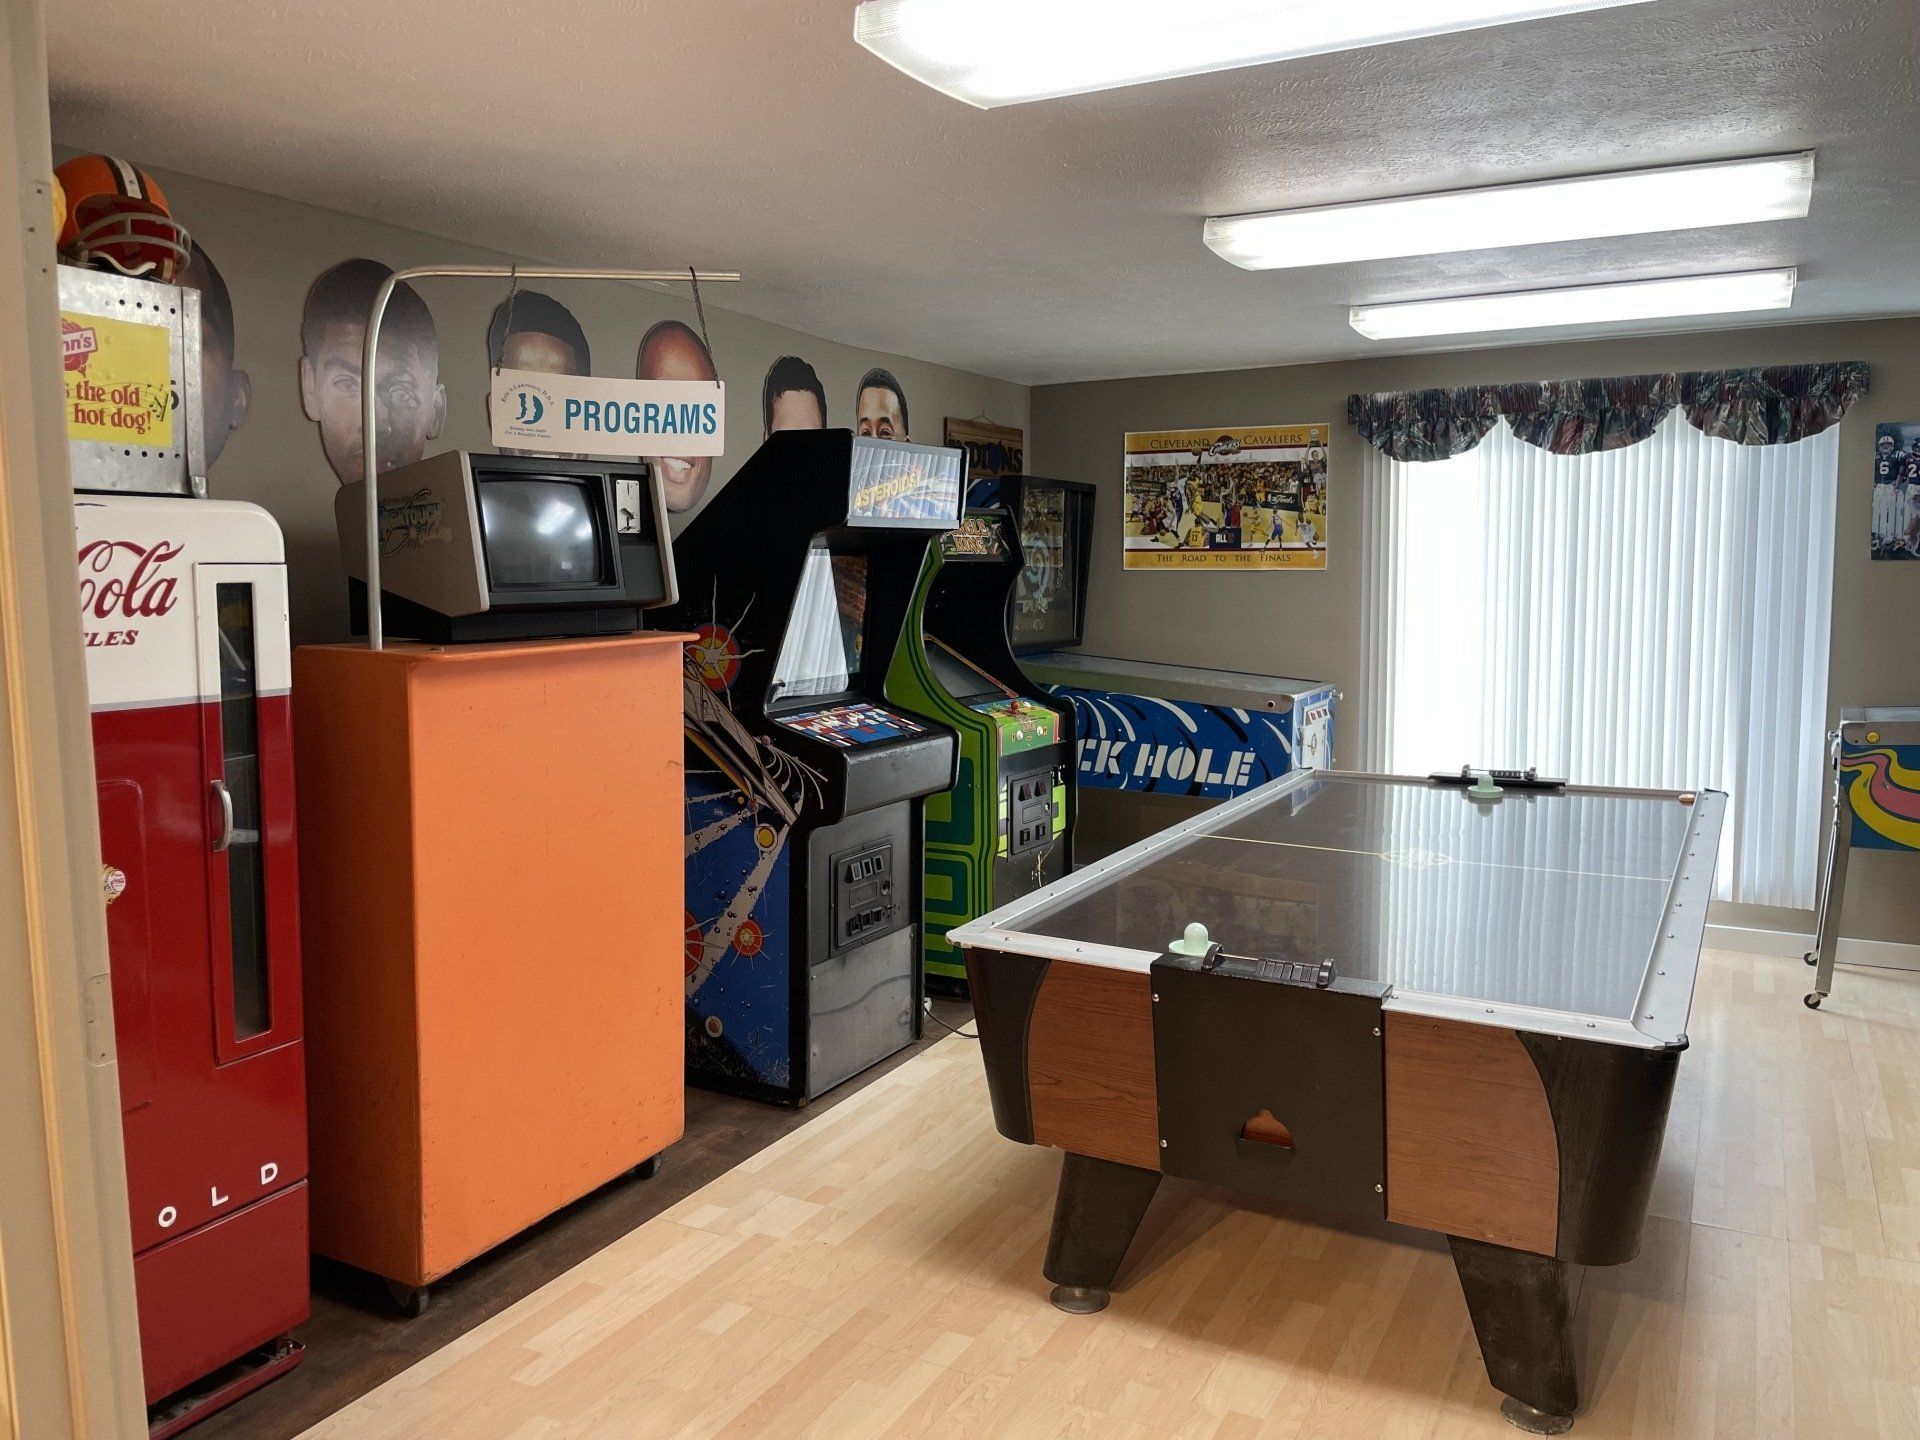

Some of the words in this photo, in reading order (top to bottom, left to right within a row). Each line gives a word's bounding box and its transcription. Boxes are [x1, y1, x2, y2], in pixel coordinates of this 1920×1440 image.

[76, 381, 105, 402] the
[111, 384, 140, 407] old
[74, 403, 105, 425] hot
[111, 409, 151, 434] dog!
[565, 398, 717, 435] PROGRAMS
[1244, 433, 1302, 445] CAVALIERS
[1880, 461, 1890, 475] 6
[1908, 463, 1920, 478] 2
[1181, 554, 1207, 562] ROAD
[1260, 553, 1291, 562] FINALS
[84, 629, 139, 647] LES
[1133, 743, 1256, 787] HOLE
